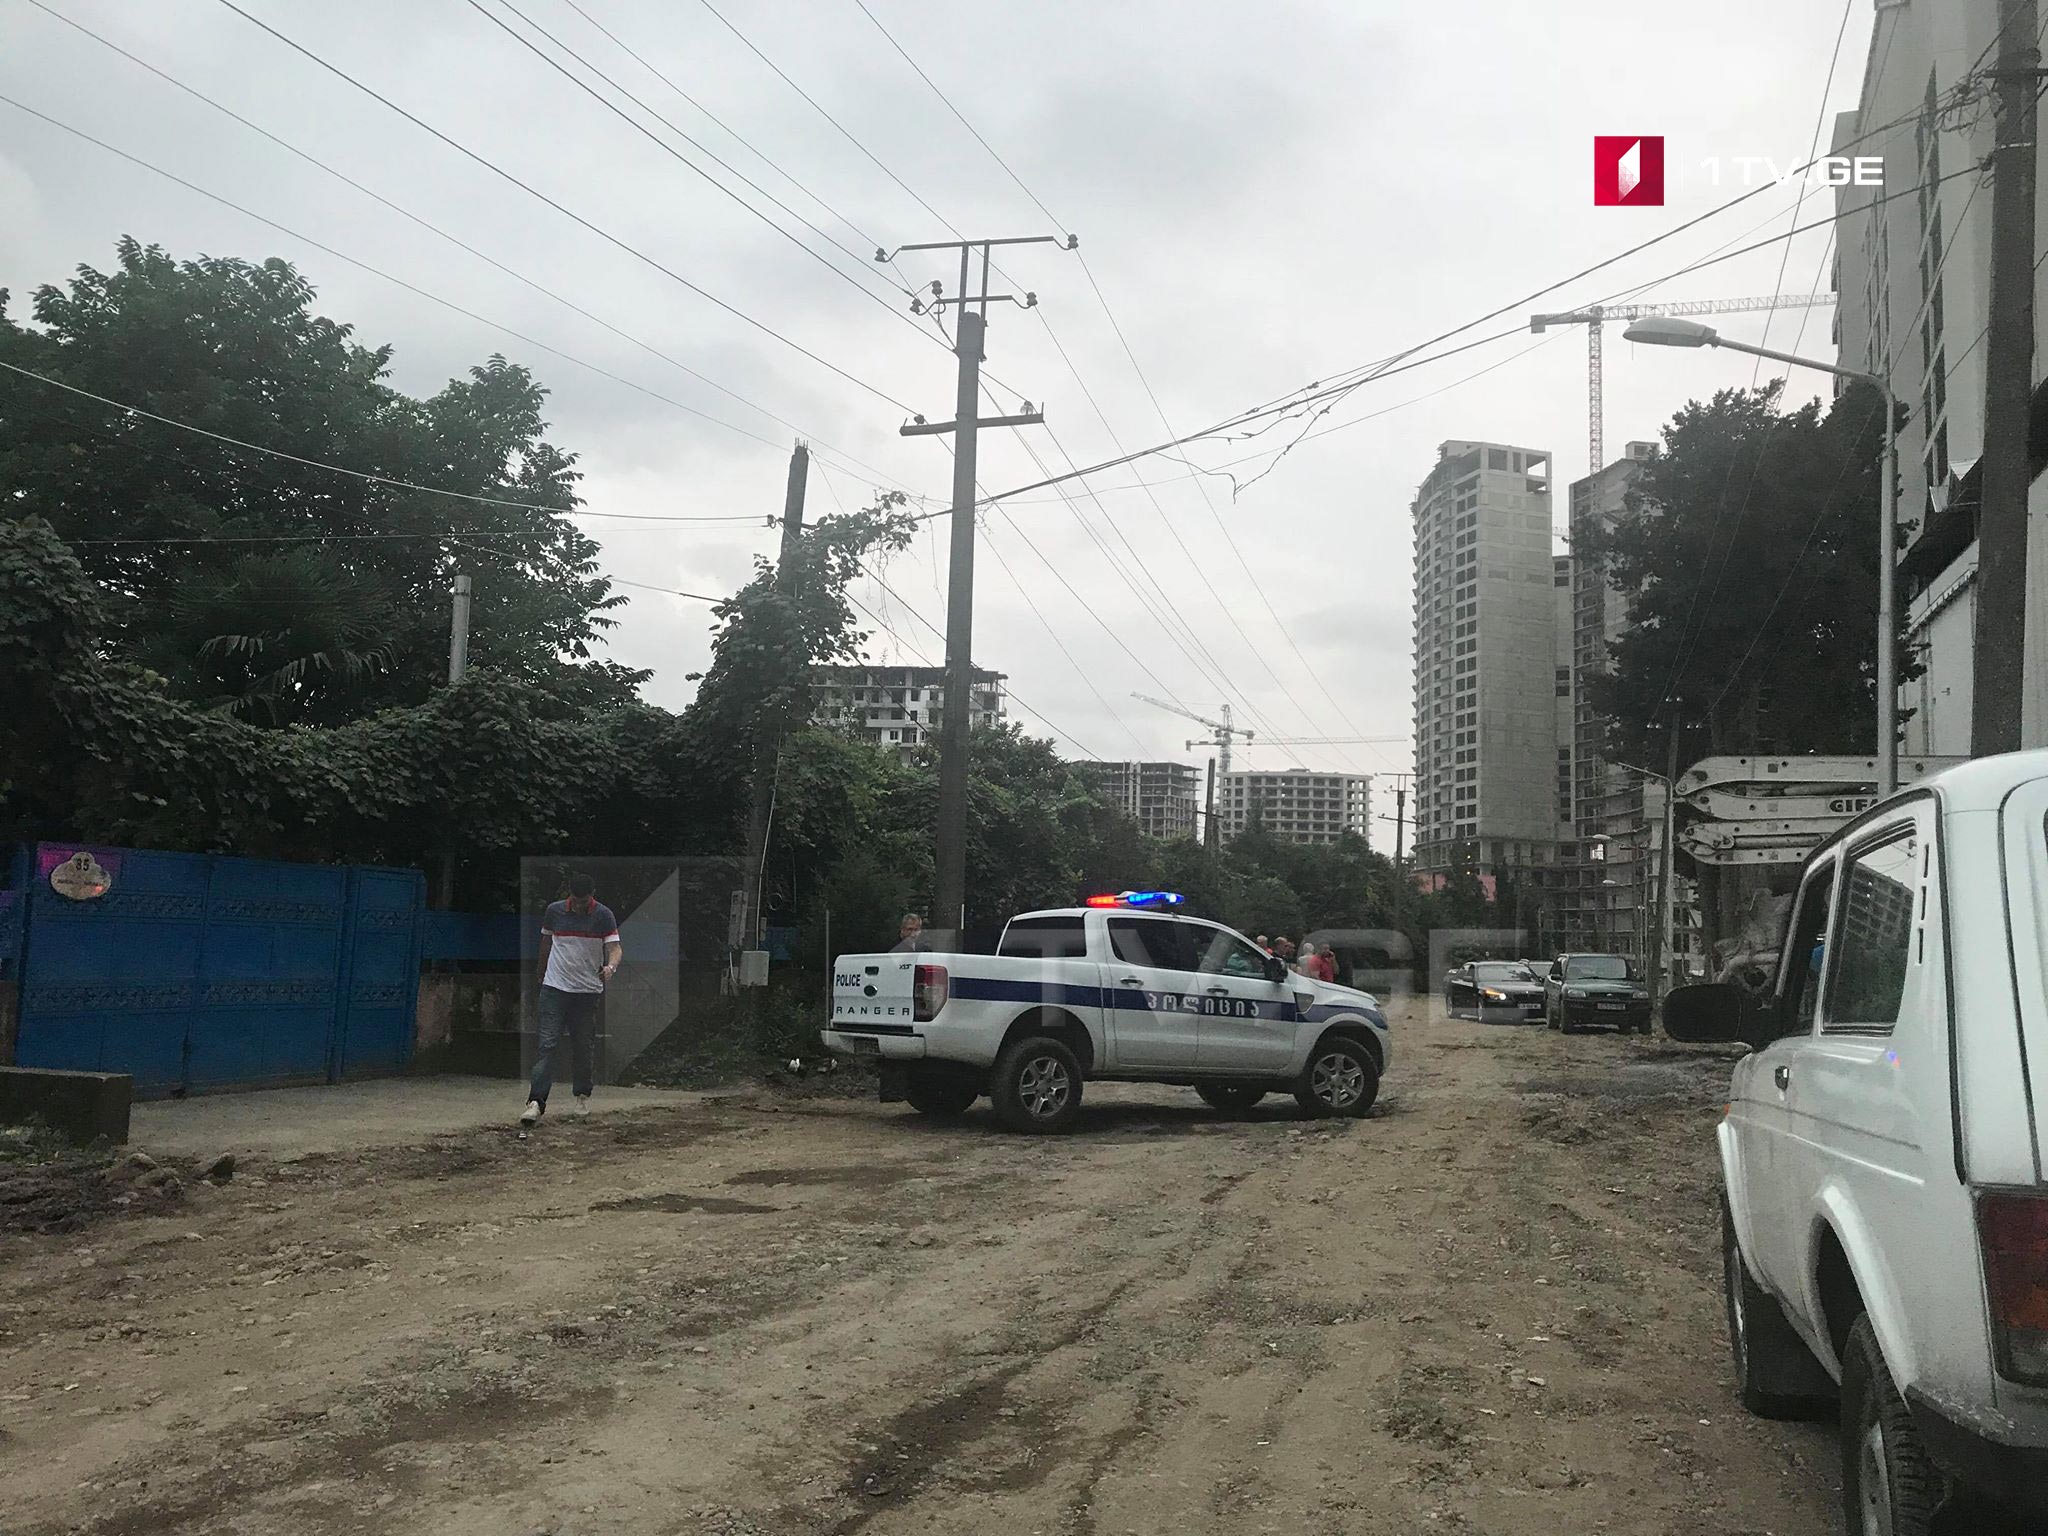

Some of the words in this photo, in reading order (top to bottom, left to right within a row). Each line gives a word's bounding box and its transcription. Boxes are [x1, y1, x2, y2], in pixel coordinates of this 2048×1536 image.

[835, 974, 861, 987] POLICE
[835, 1006, 911, 1016] RANGER
[1147, 992, 1260, 1017] პოლიცია
